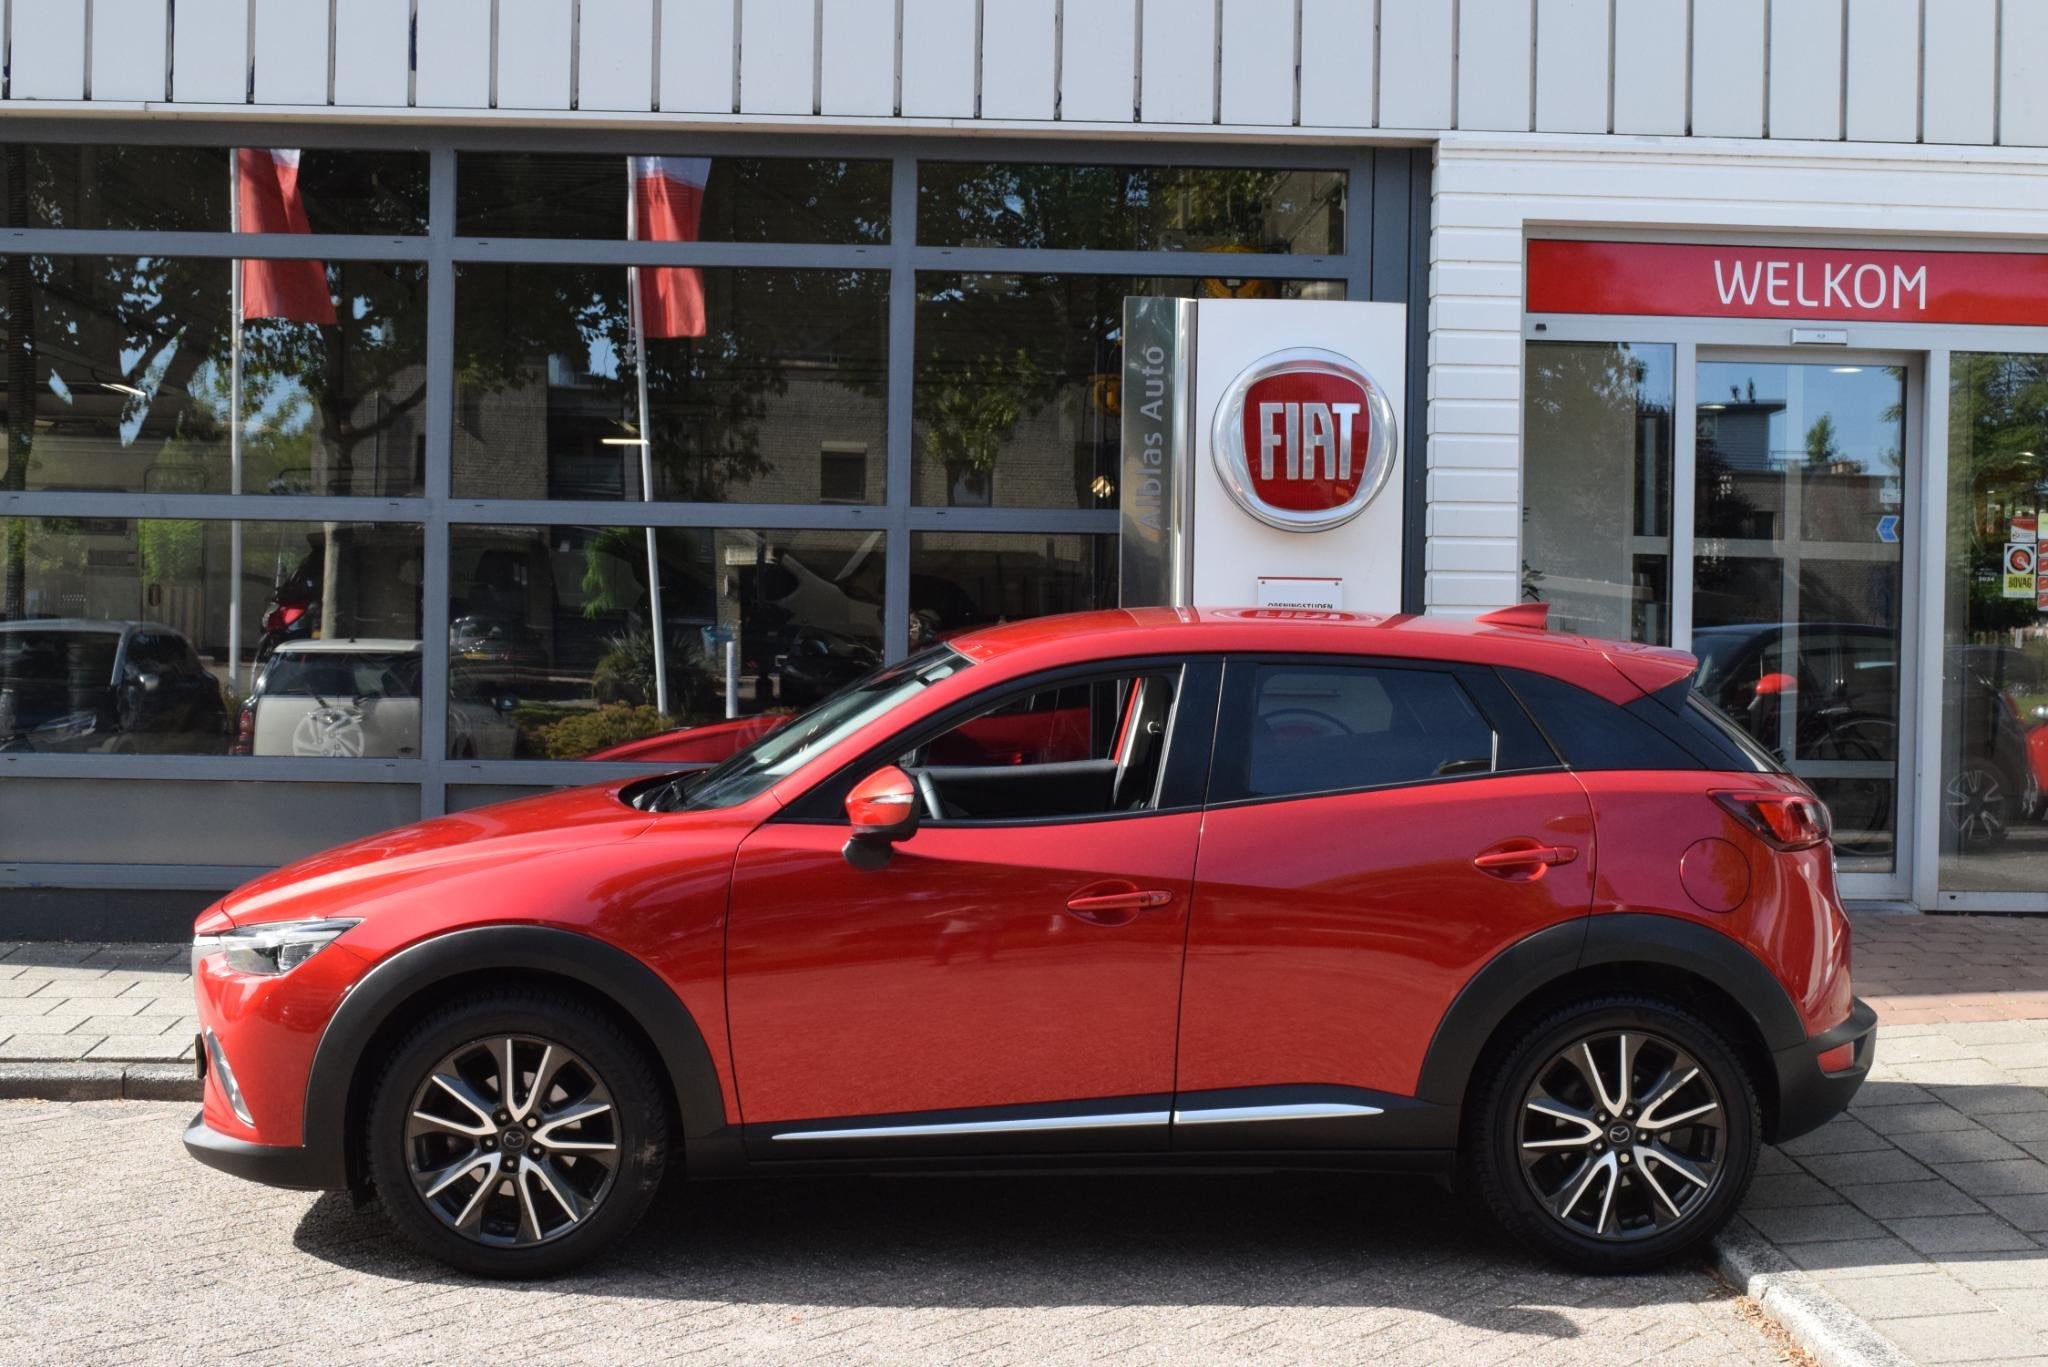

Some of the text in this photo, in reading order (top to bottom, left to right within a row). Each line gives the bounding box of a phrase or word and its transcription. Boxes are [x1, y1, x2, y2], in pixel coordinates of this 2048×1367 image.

[1714, 260, 1927, 310] WELKOM
[1135, 345, 1165, 530] Alblas Auto
[1259, 402, 1361, 481] FIAT
[2008, 576, 2032, 589] BOVAG
